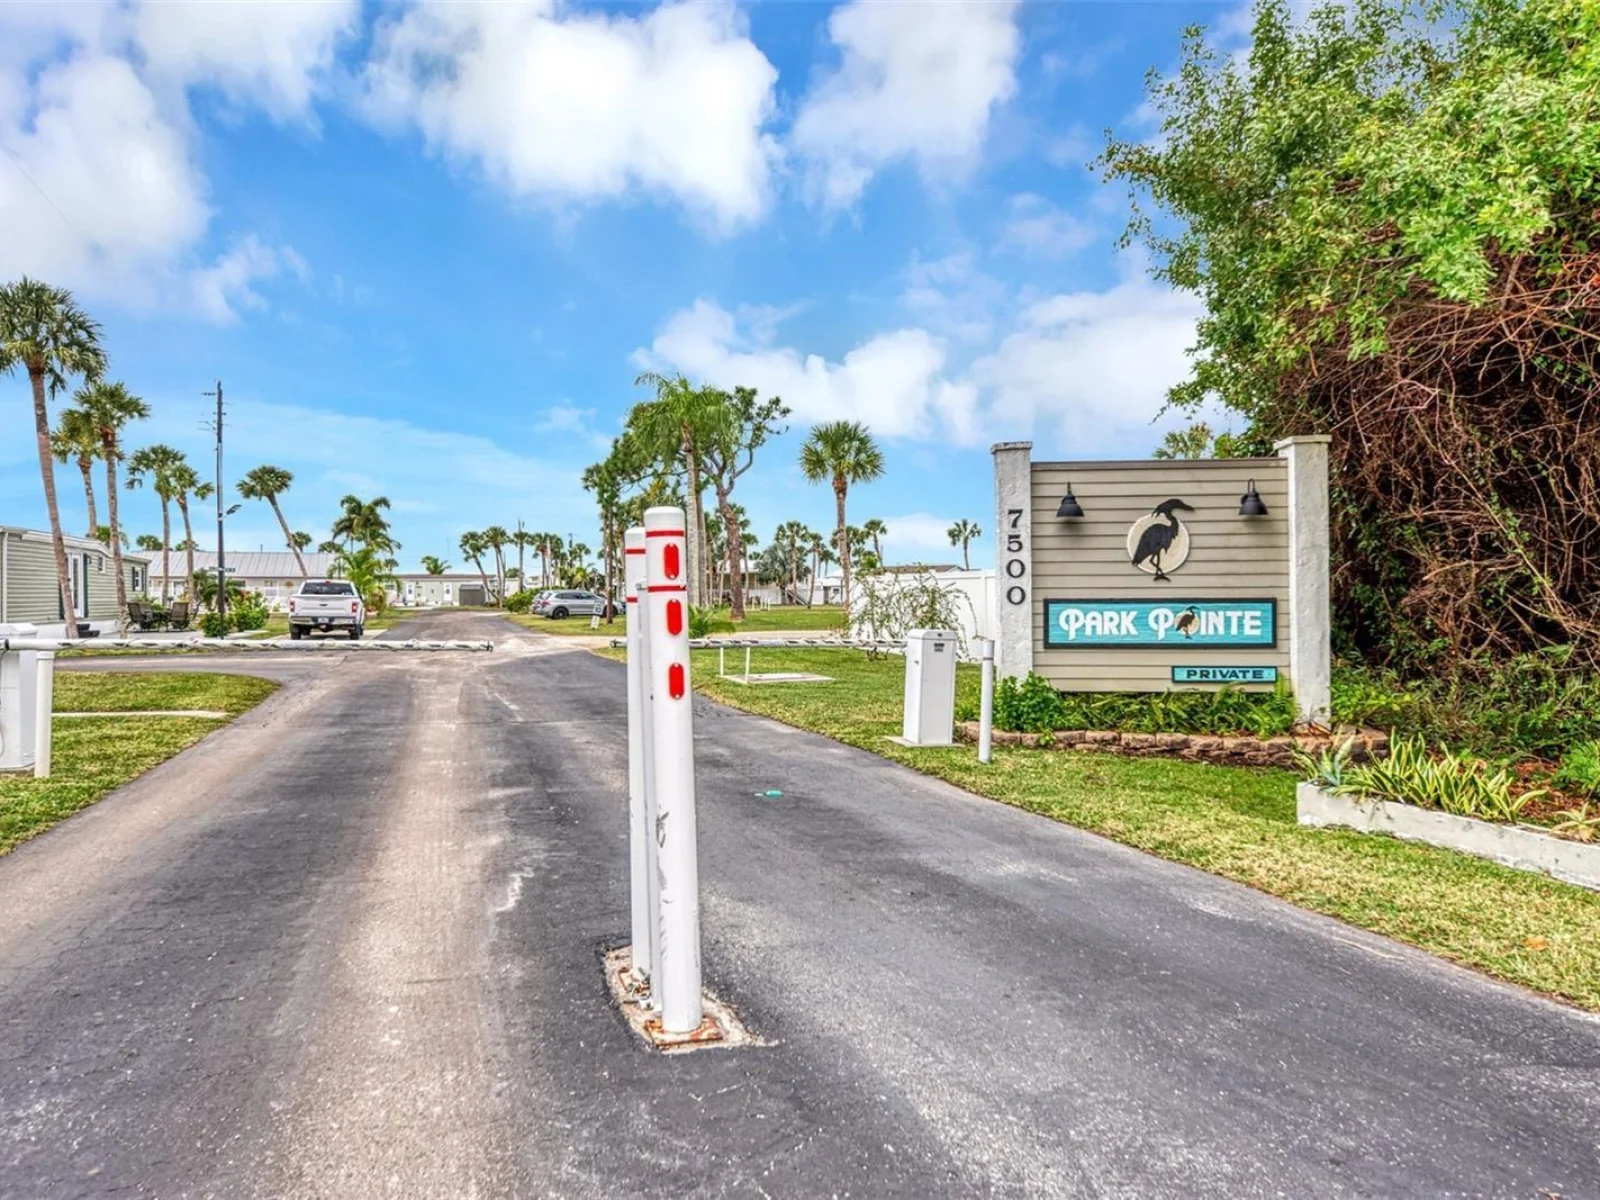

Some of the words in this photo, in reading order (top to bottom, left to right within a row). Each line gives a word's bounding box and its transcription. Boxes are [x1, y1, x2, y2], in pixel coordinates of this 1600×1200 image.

[1006, 508, 1026, 606] 7500
[1058, 608, 1138, 640] PARK
[1186, 669, 1264, 679] PRIVATE
